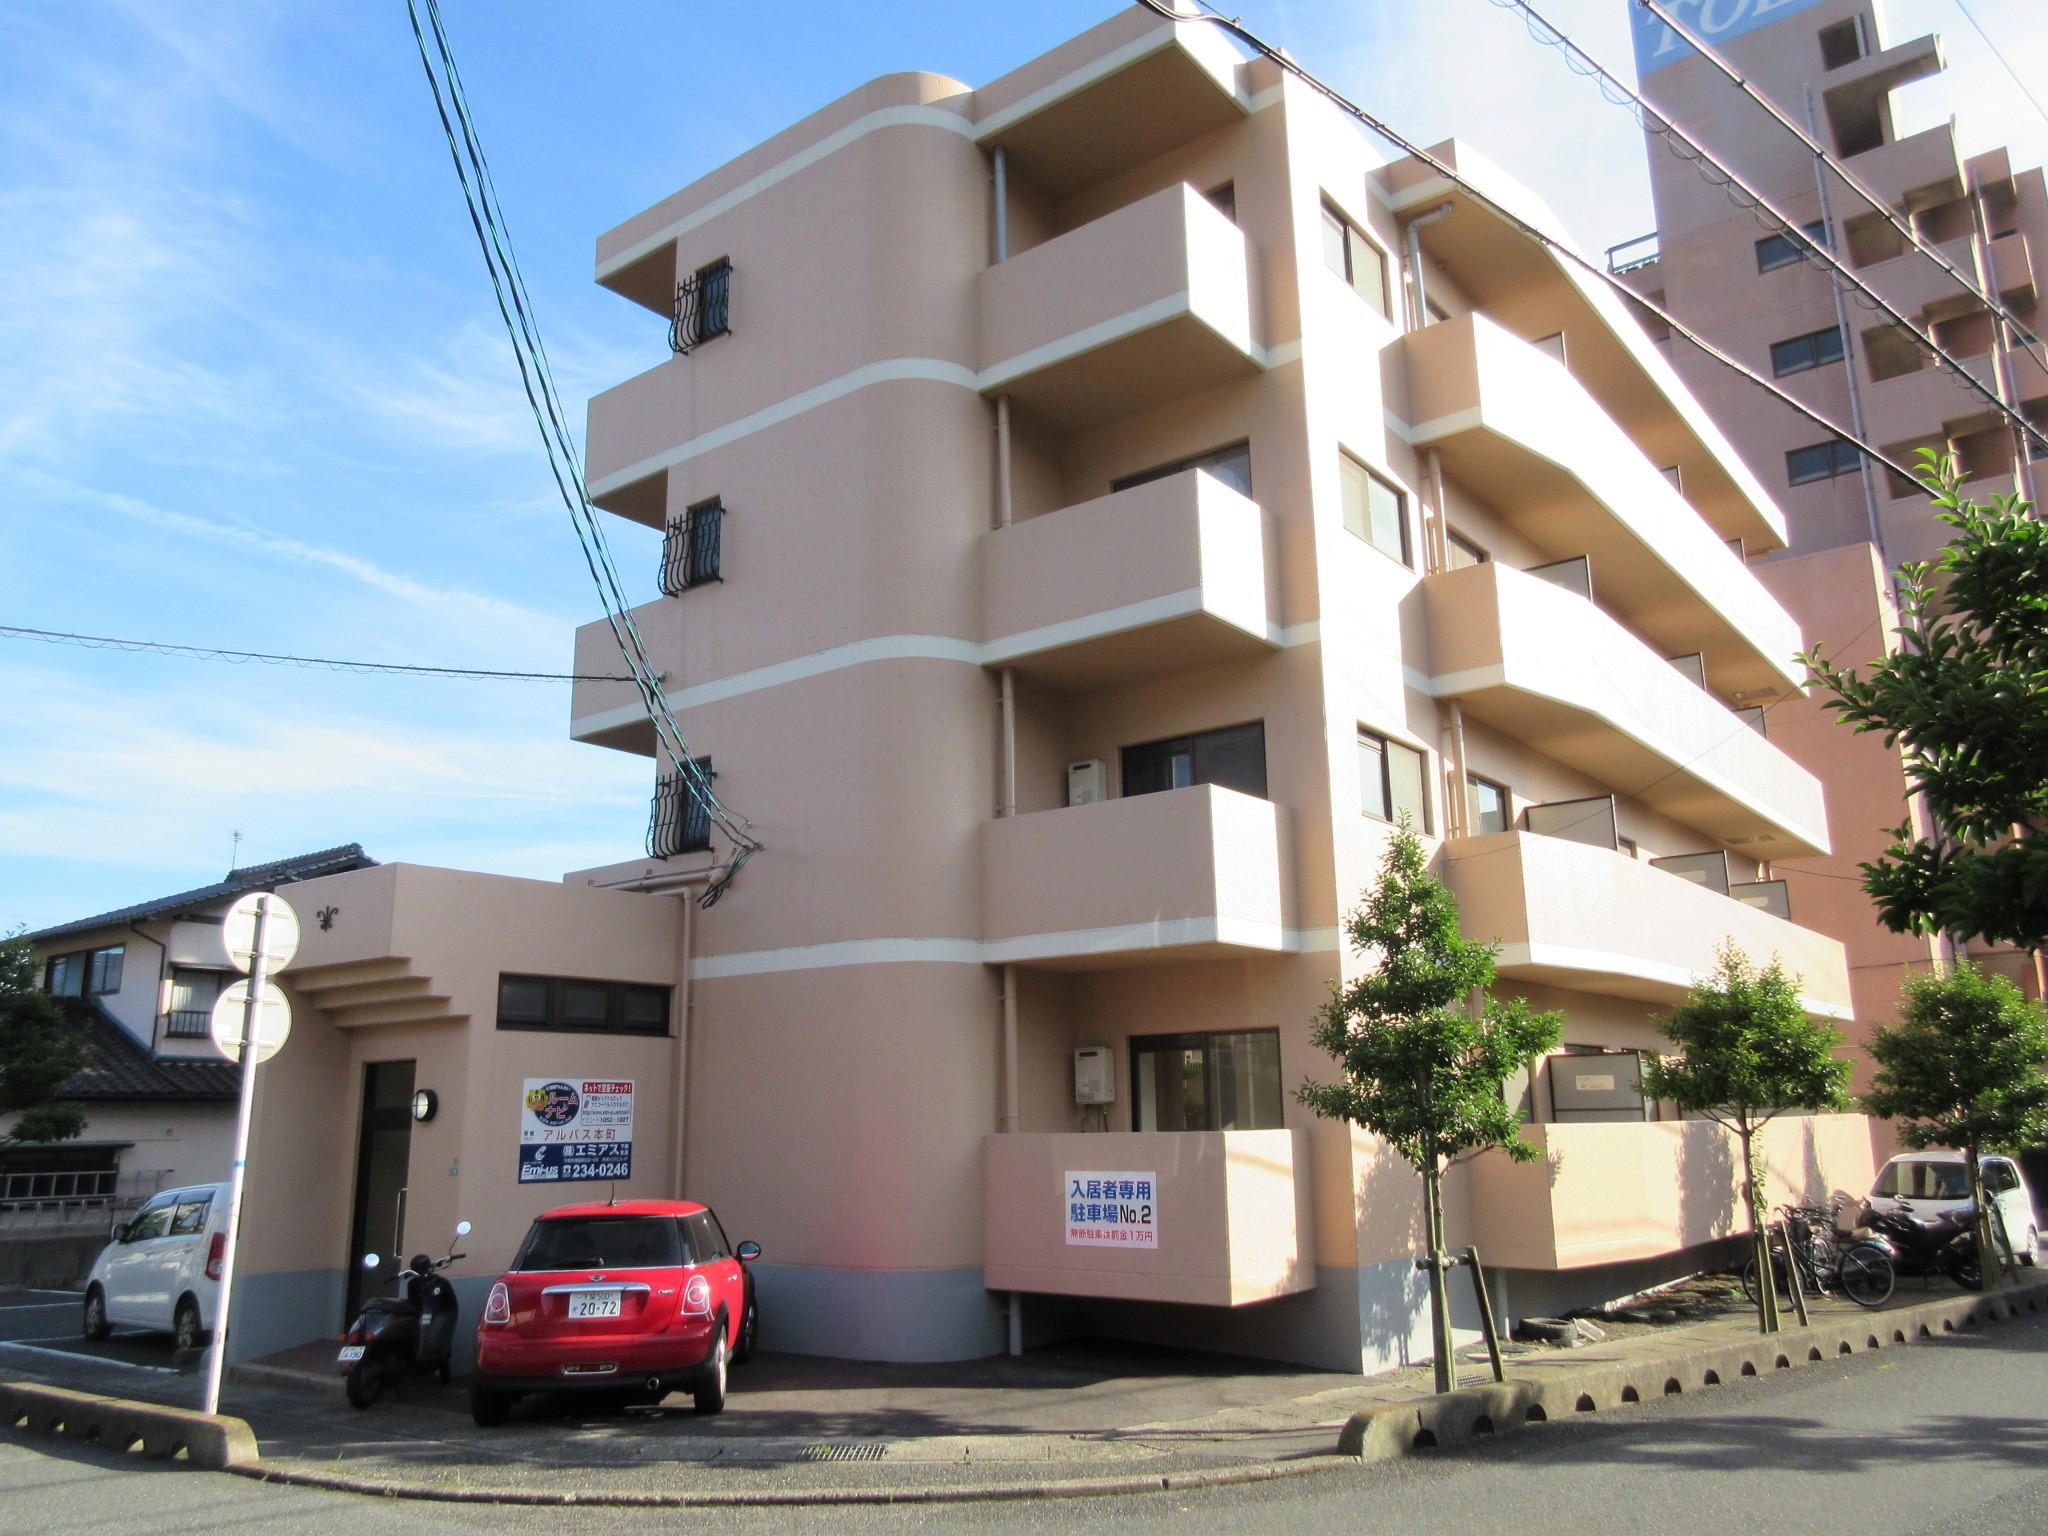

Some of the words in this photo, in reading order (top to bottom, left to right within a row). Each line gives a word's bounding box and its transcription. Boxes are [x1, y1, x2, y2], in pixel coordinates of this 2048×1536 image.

[572, 1163, 628, 1178] 234-0246
[1070, 1180, 1151, 1200] 入居者専用
[1070, 1203, 1152, 1224] 駐車場No.2
[580, 1302, 617, 1316] 20-72
